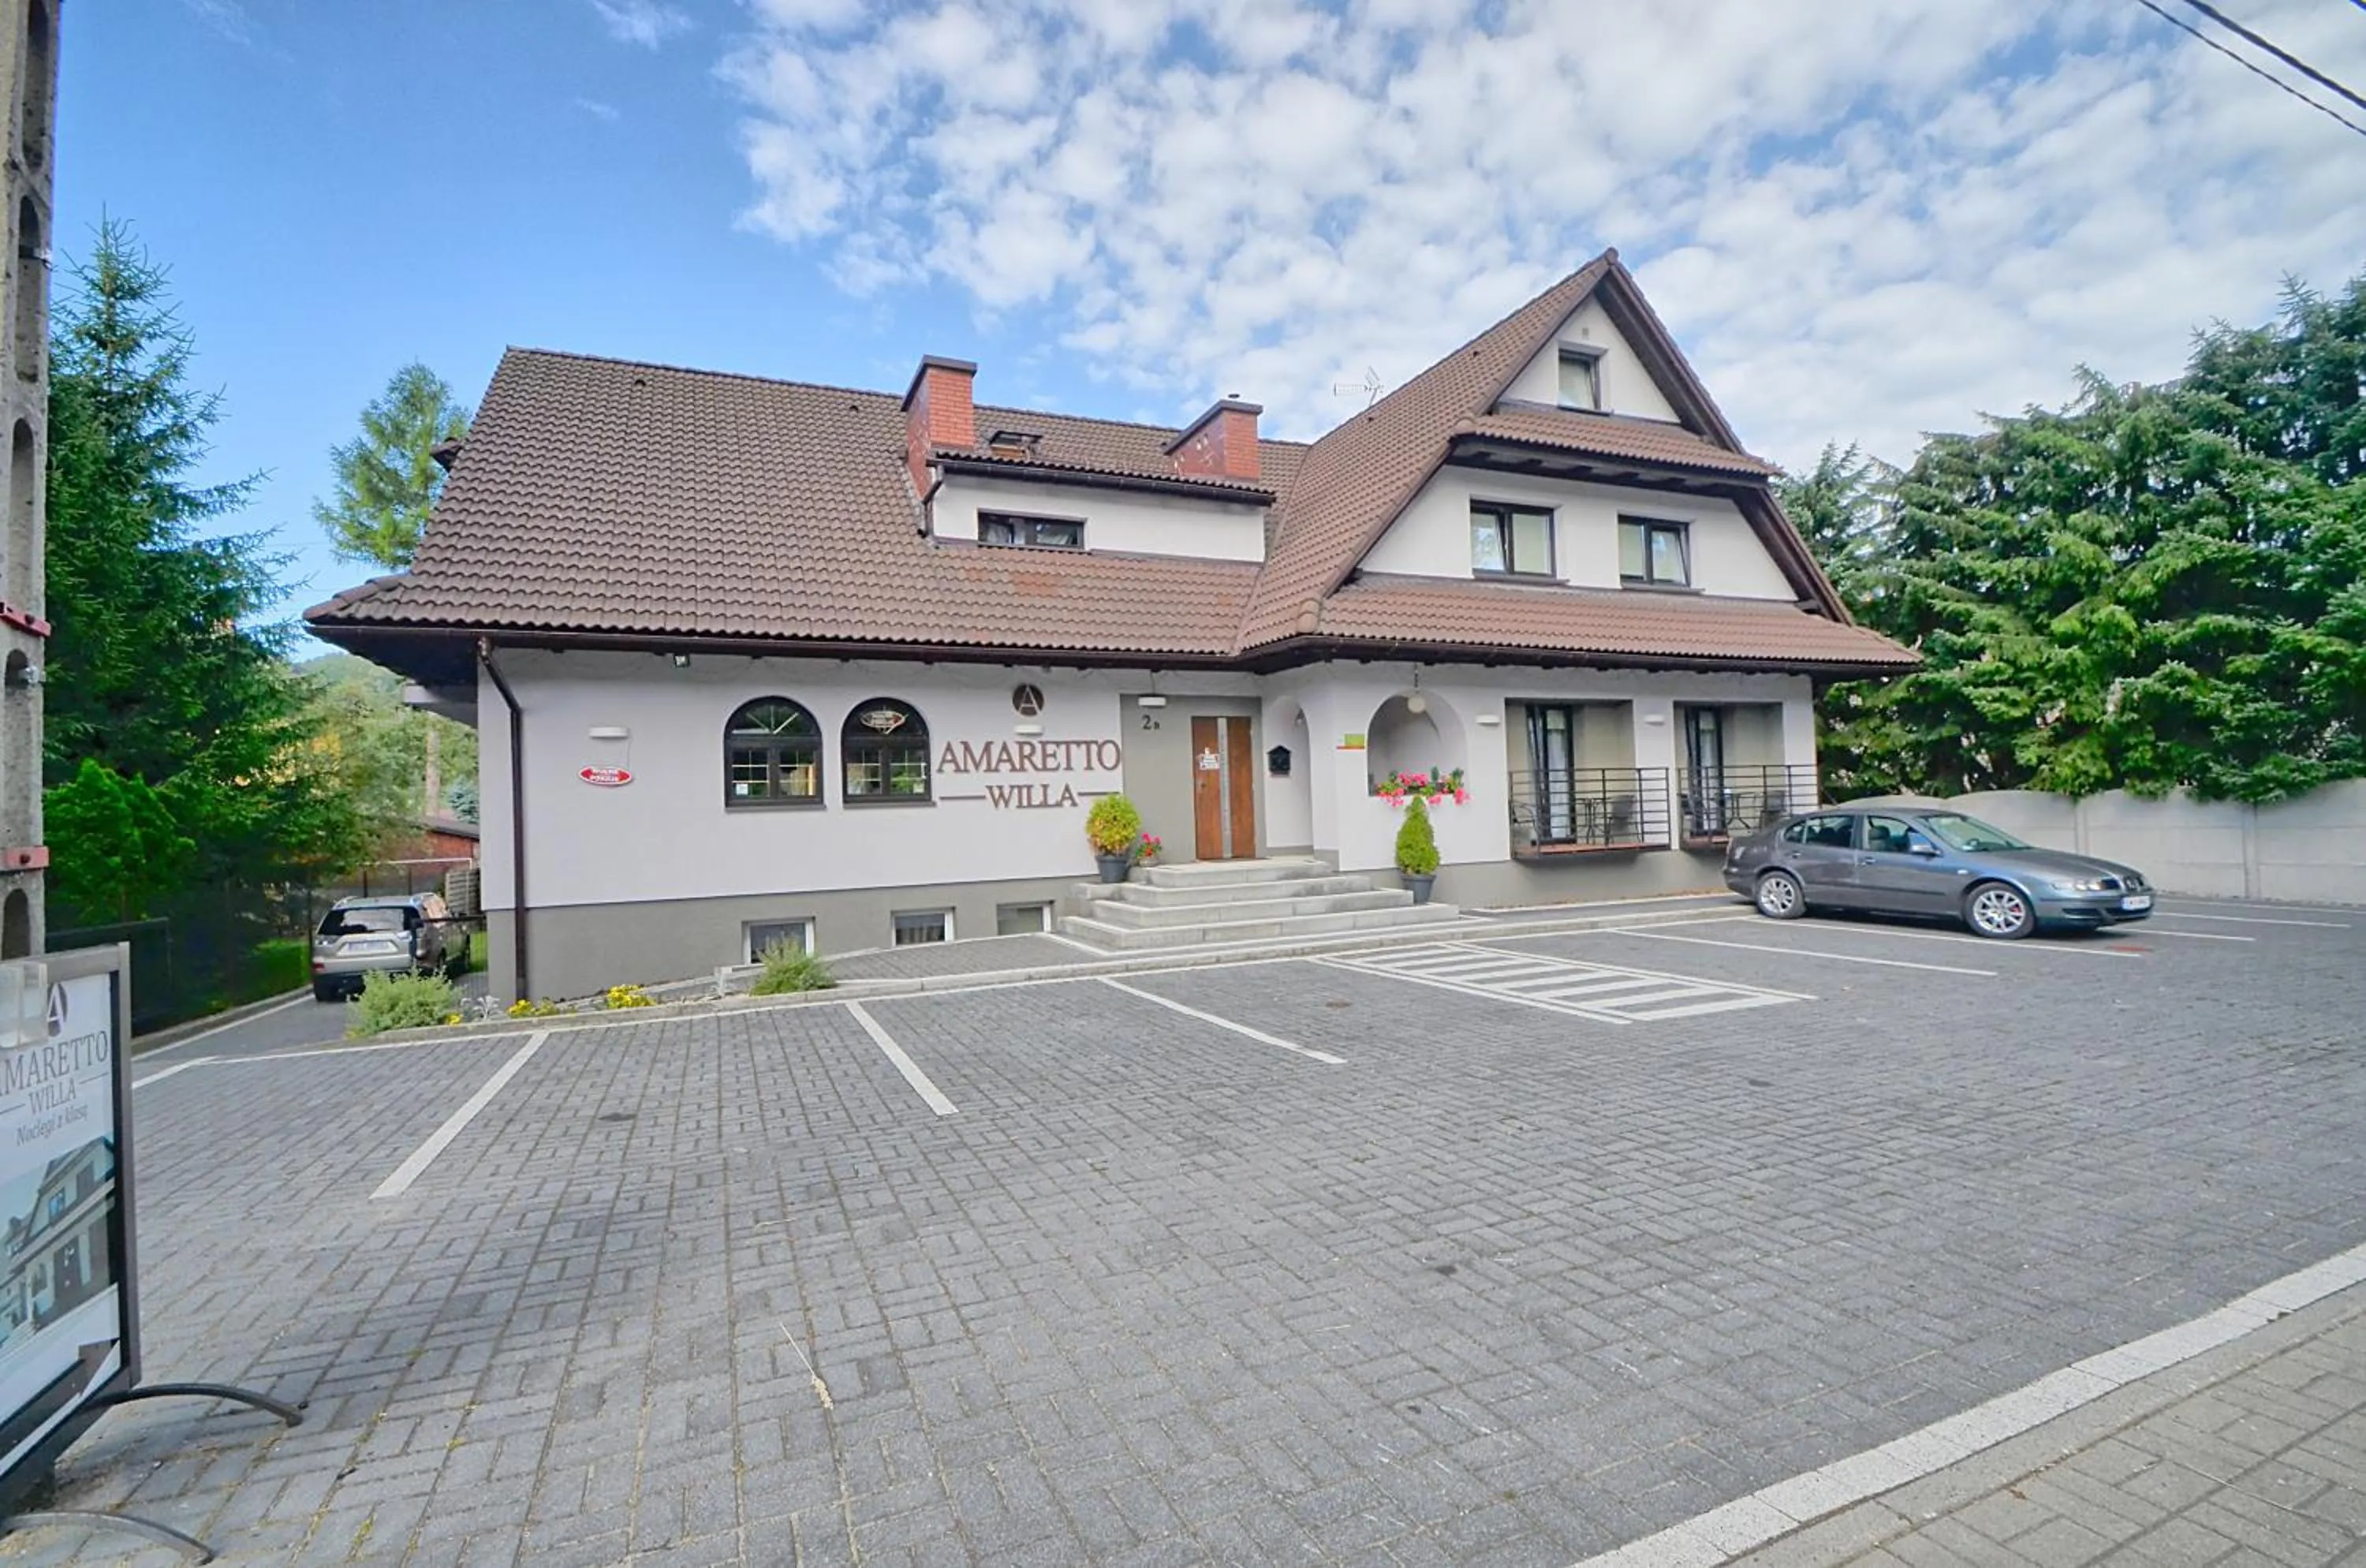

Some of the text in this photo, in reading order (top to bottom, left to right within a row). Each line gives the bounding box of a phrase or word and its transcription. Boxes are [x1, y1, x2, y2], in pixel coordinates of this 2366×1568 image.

[1015, 684, 1043, 716] A
[936, 739, 1121, 773] AMARETTO
[986, 782, 1079, 808] WILLA
[0, 1029, 109, 1097] MARETTO
[28, 1077, 77, 1115] WILLA
